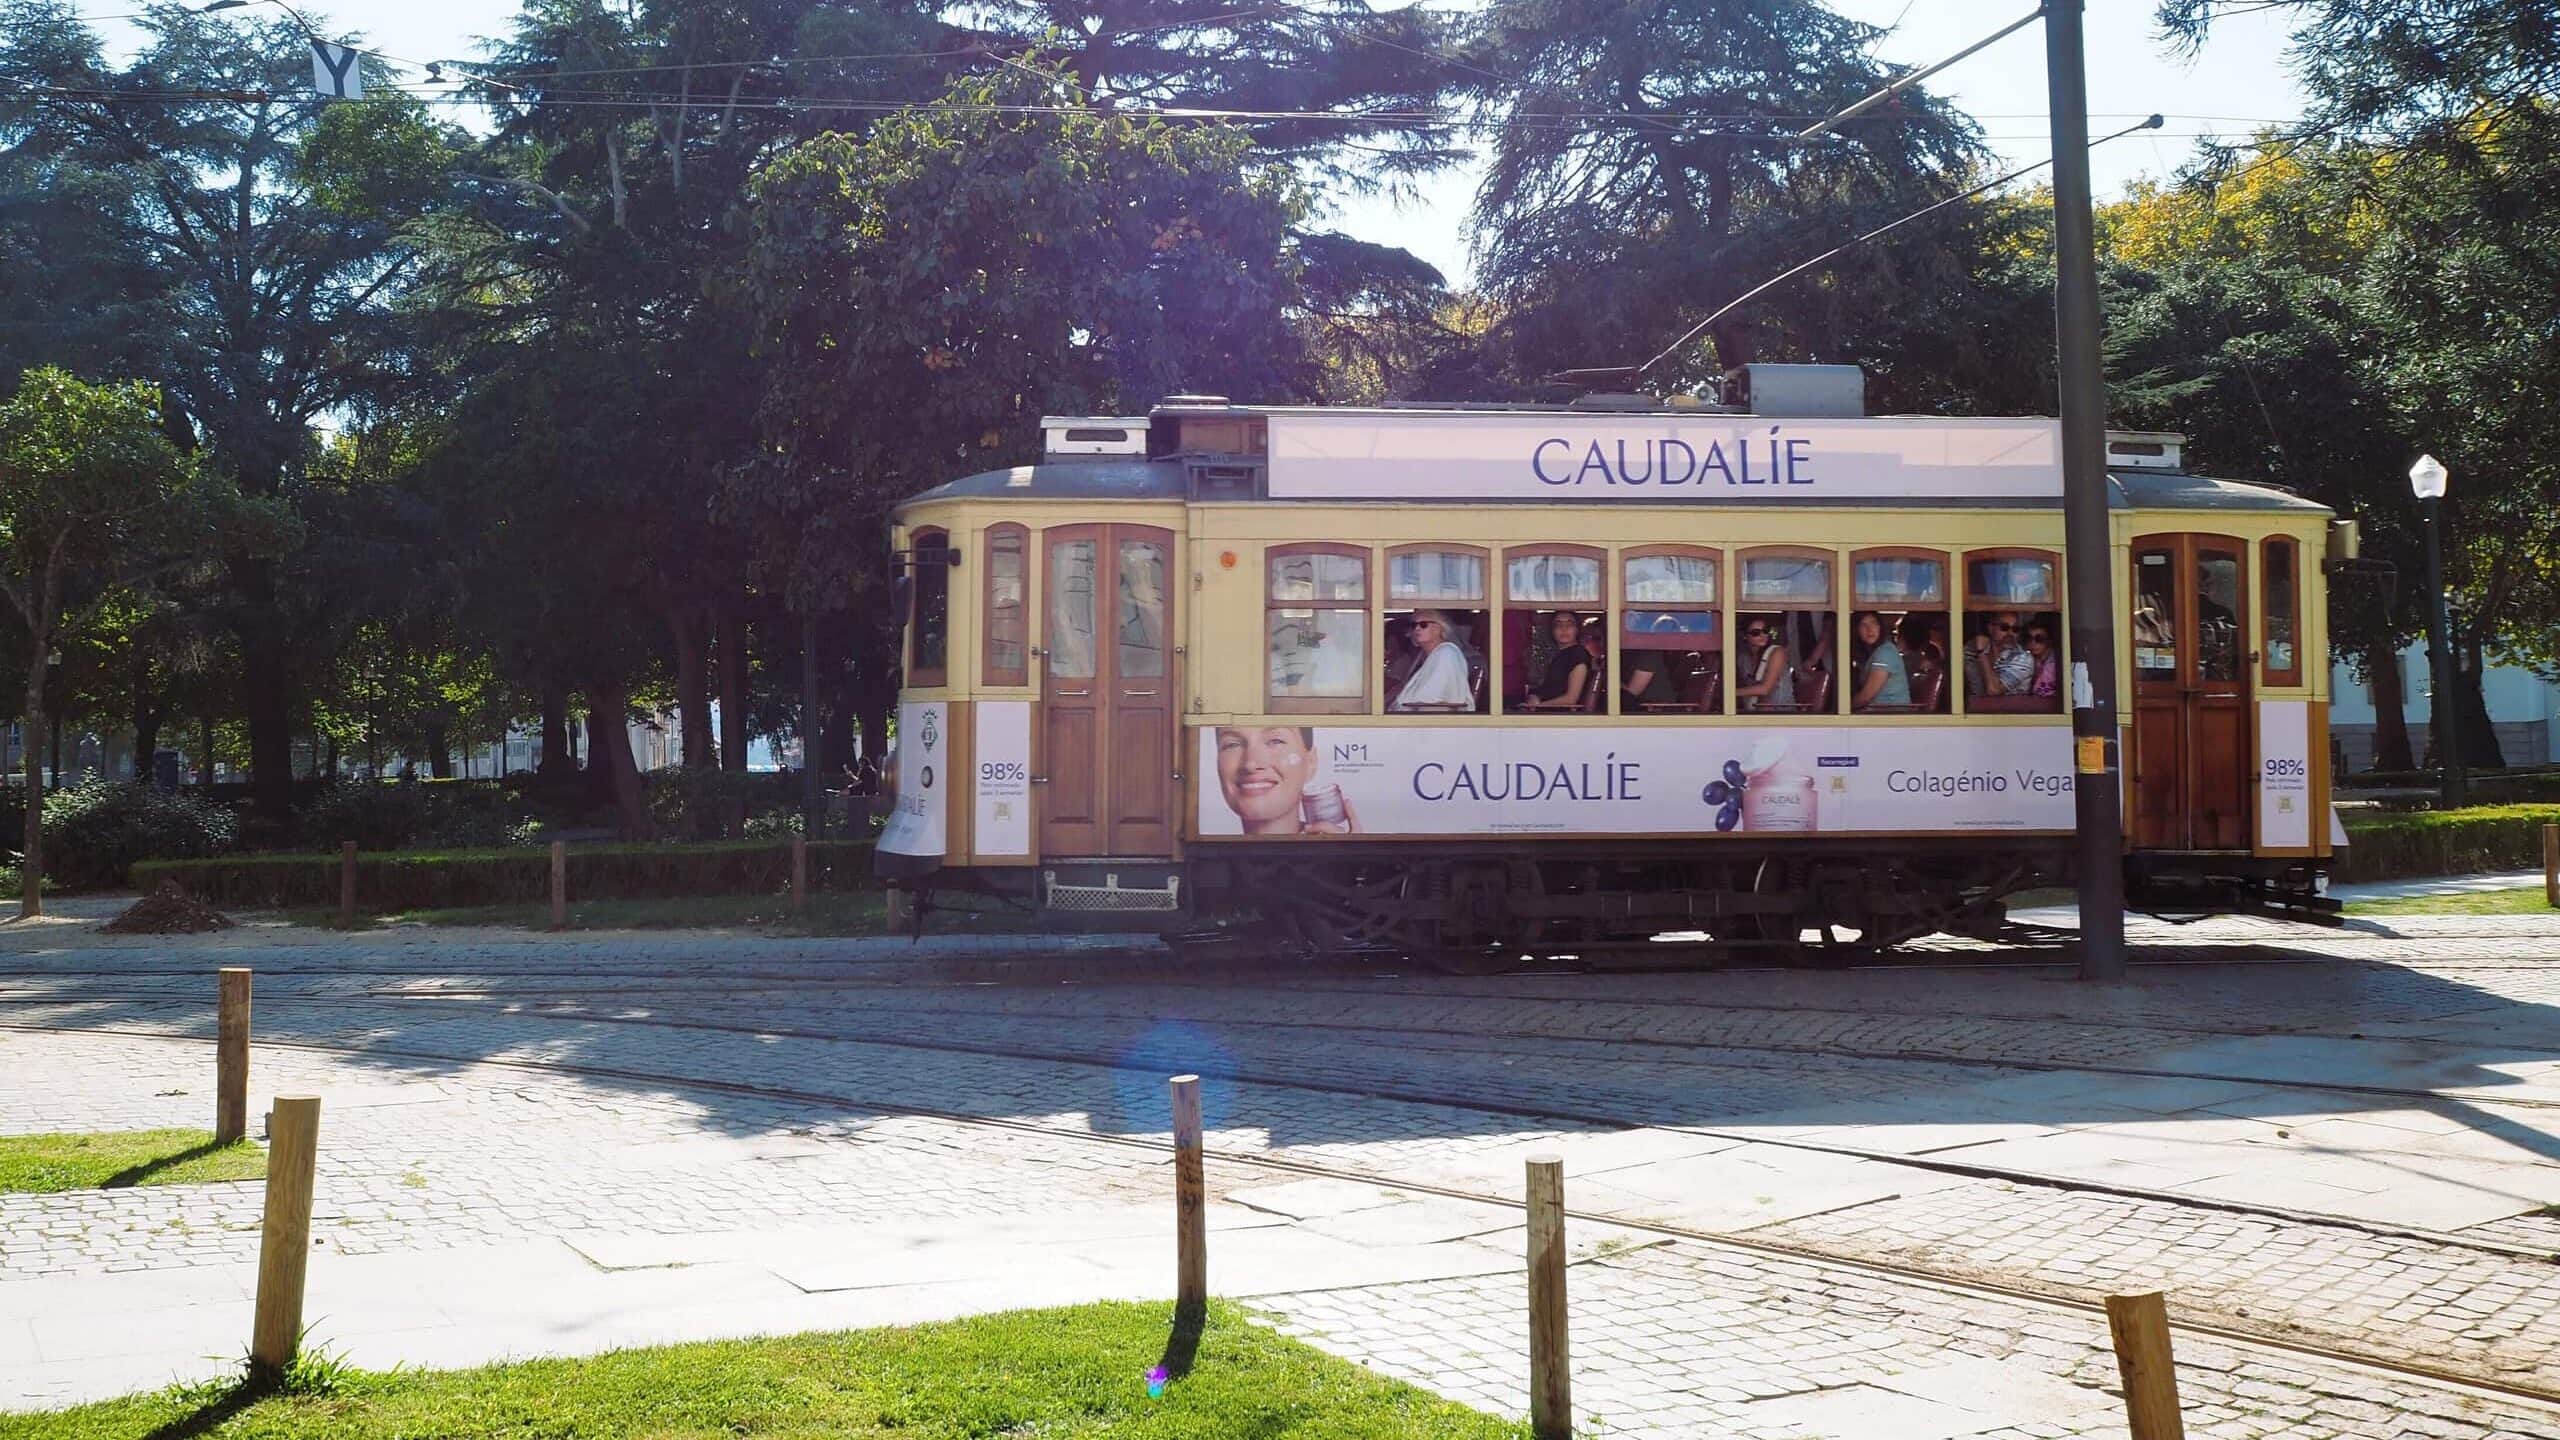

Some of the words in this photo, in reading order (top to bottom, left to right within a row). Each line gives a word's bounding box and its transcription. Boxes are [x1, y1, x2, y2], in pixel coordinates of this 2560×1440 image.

[1532, 424, 1815, 486] CAUDALÍE
[981, 762, 1025, 780] 98%
[1412, 751, 1642, 801] CAUDALÍE
[2265, 759, 2305, 776] 98%
[1886, 769, 2008, 797] Colagénio
